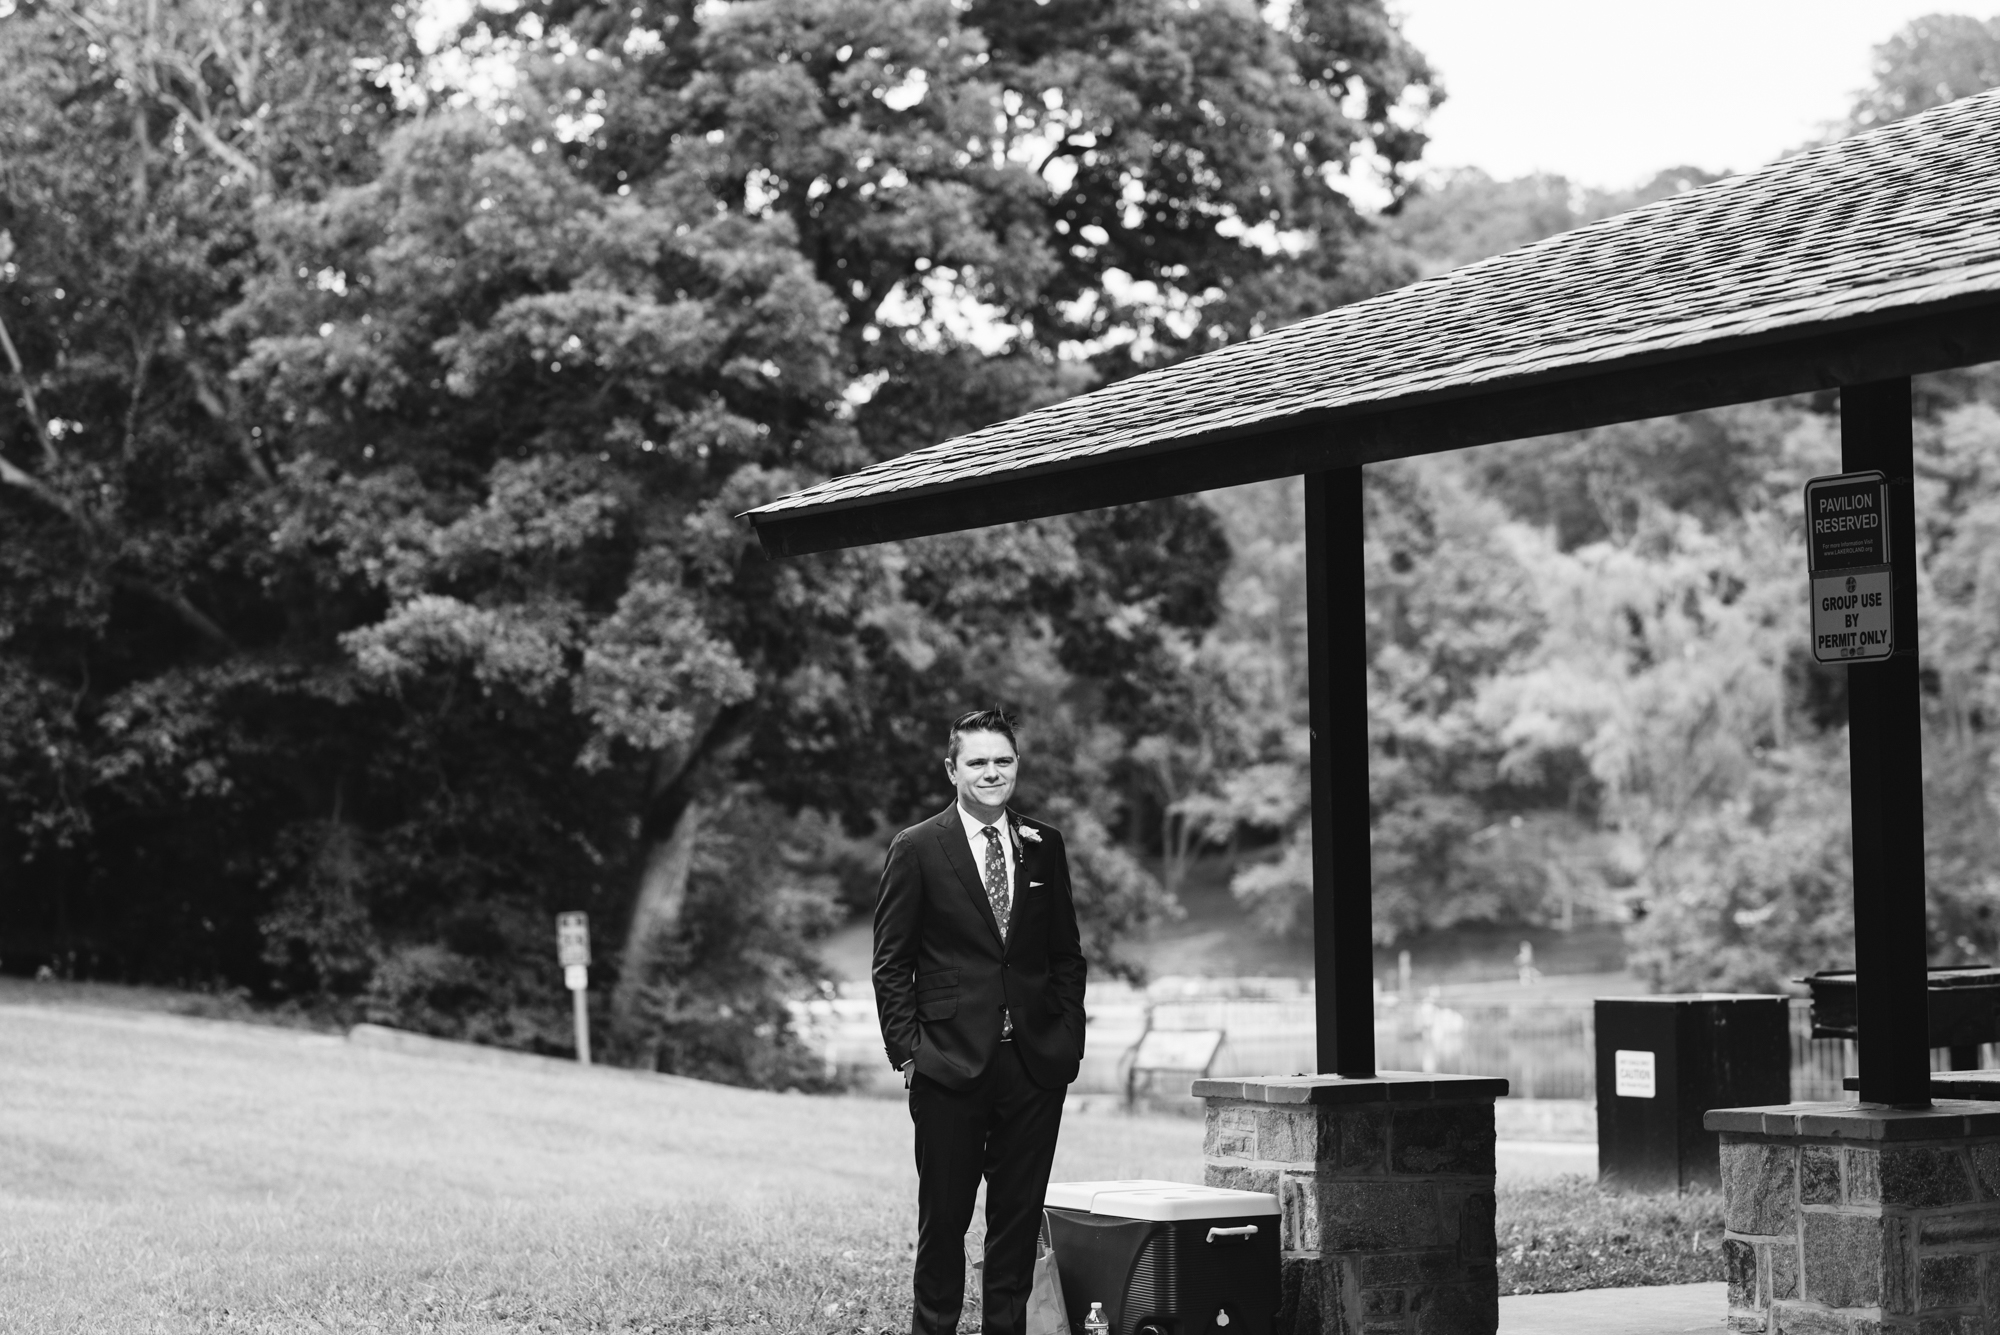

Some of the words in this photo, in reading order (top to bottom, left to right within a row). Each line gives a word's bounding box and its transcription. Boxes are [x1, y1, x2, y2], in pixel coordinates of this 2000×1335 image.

[1819, 493, 1872, 514] PAVILION
[1815, 513, 1879, 534] RESERVED
[1822, 594, 1859, 612] GROUP
[1861, 592, 1882, 608] USE
[1845, 613, 1859, 628] BY
[1818, 632, 1857, 649] PERMIT
[1859, 629, 1887, 646] ONLY
